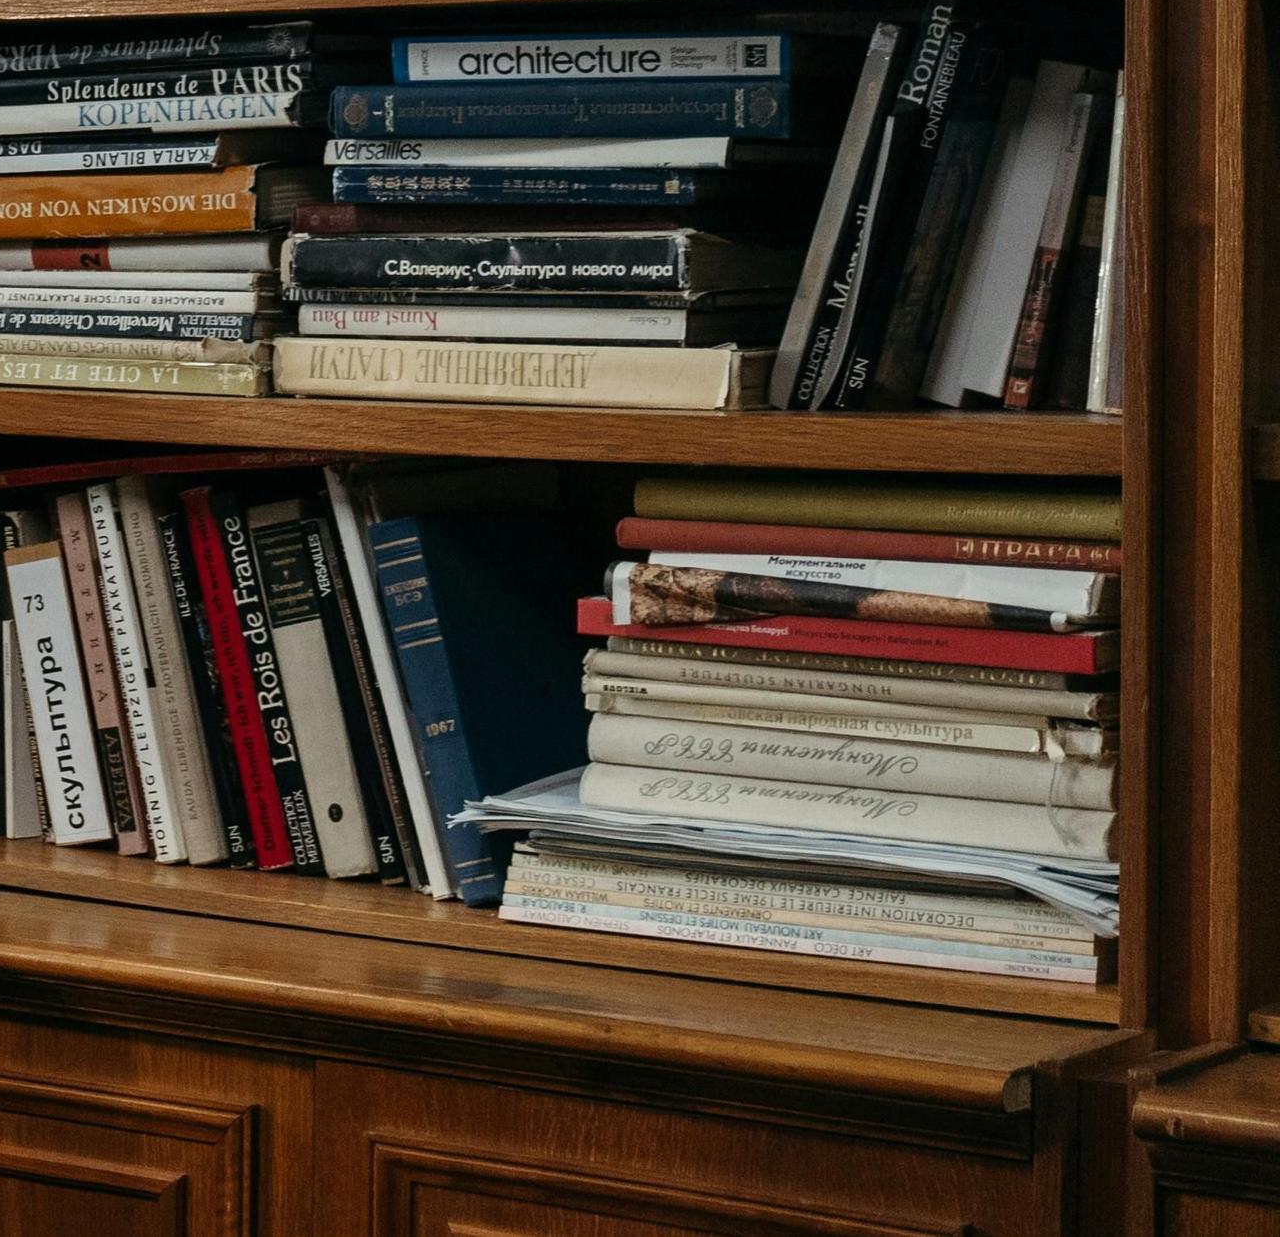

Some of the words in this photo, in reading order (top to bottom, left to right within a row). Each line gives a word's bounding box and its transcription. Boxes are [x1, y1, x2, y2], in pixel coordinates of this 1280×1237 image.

[458, 45, 663, 76] architecture
[47, 76, 166, 103] Splendeurs
[174, 74, 199, 95] de
[211, 64, 303, 95] PARIS
[920, 31, 966, 149] FONTAINEBLEAU
[77, 94, 279, 129] KOPENHAGEN
[5, 140, 42, 156] DAS
[151, 147, 210, 166] KARLA
[332, 139, 423, 161] Versailles
[81, 150, 146, 168] BILANG
[37, 200, 82, 217] VON
[86, 194, 196, 215] MOSAIKEN
[200, 192, 236, 210] DIE
[477, 259, 558, 280] Скульптура
[571, 264, 627, 276] нового
[630, 262, 674, 278] мира
[7, 291, 81, 304] PLAKATKUNST
[84, 293, 141, 305] DEUTSCHE
[150, 295, 226, 307] RADEMACHER
[8, 311, 27, 327] de
[29, 312, 94, 331] Châteaux
[96, 313, 175, 332] Merveilleux
[312, 309, 348, 330] Bau
[351, 310, 380, 324] am
[383, 310, 439, 331] Kunst
[3, 360, 40, 379] LES
[54, 364, 78, 381] ET
[307, 344, 405, 383] СТАТУИ
[88, 365, 141, 384] CITÉ
[151, 367, 180, 385] LA
[848, 357, 870, 390] SUN
[89, 489, 127, 636] PLAKATKUNST
[223, 515, 256, 606] France
[306, 533, 332, 597] VERSAILLES
[767, 554, 867, 572] Монументальное
[163, 527, 192, 618] ILE-DE-FRANCE
[784, 568, 843, 581] искусство
[22, 592, 45, 614] 73
[242, 612, 266, 644] de
[255, 651, 283, 711] Rois
[119, 645, 150, 752] LEIPZIGER
[37, 635, 88, 830] скульптура
[269, 717, 298, 765] Les
[141, 773, 169, 856] HORNIG
[228, 825, 244, 853] SUN
[281, 795, 308, 866] COLLECTION
[377, 834, 395, 864] SUN
[520, 896, 575, 914] BEAUCLAIR
[639, 911, 687, 928] DESSINS
[688, 914, 703, 928] ET
[703, 916, 739, 932] MOTIFS
[656, 924, 715, 943] PLAFONDS
[717, 930, 732, 944] ET
[743, 921, 796, 938] NOUVEAU
[799, 926, 824, 941] ART
[733, 931, 797, 951] PANNEAUX
[848, 943, 873, 958] ART
